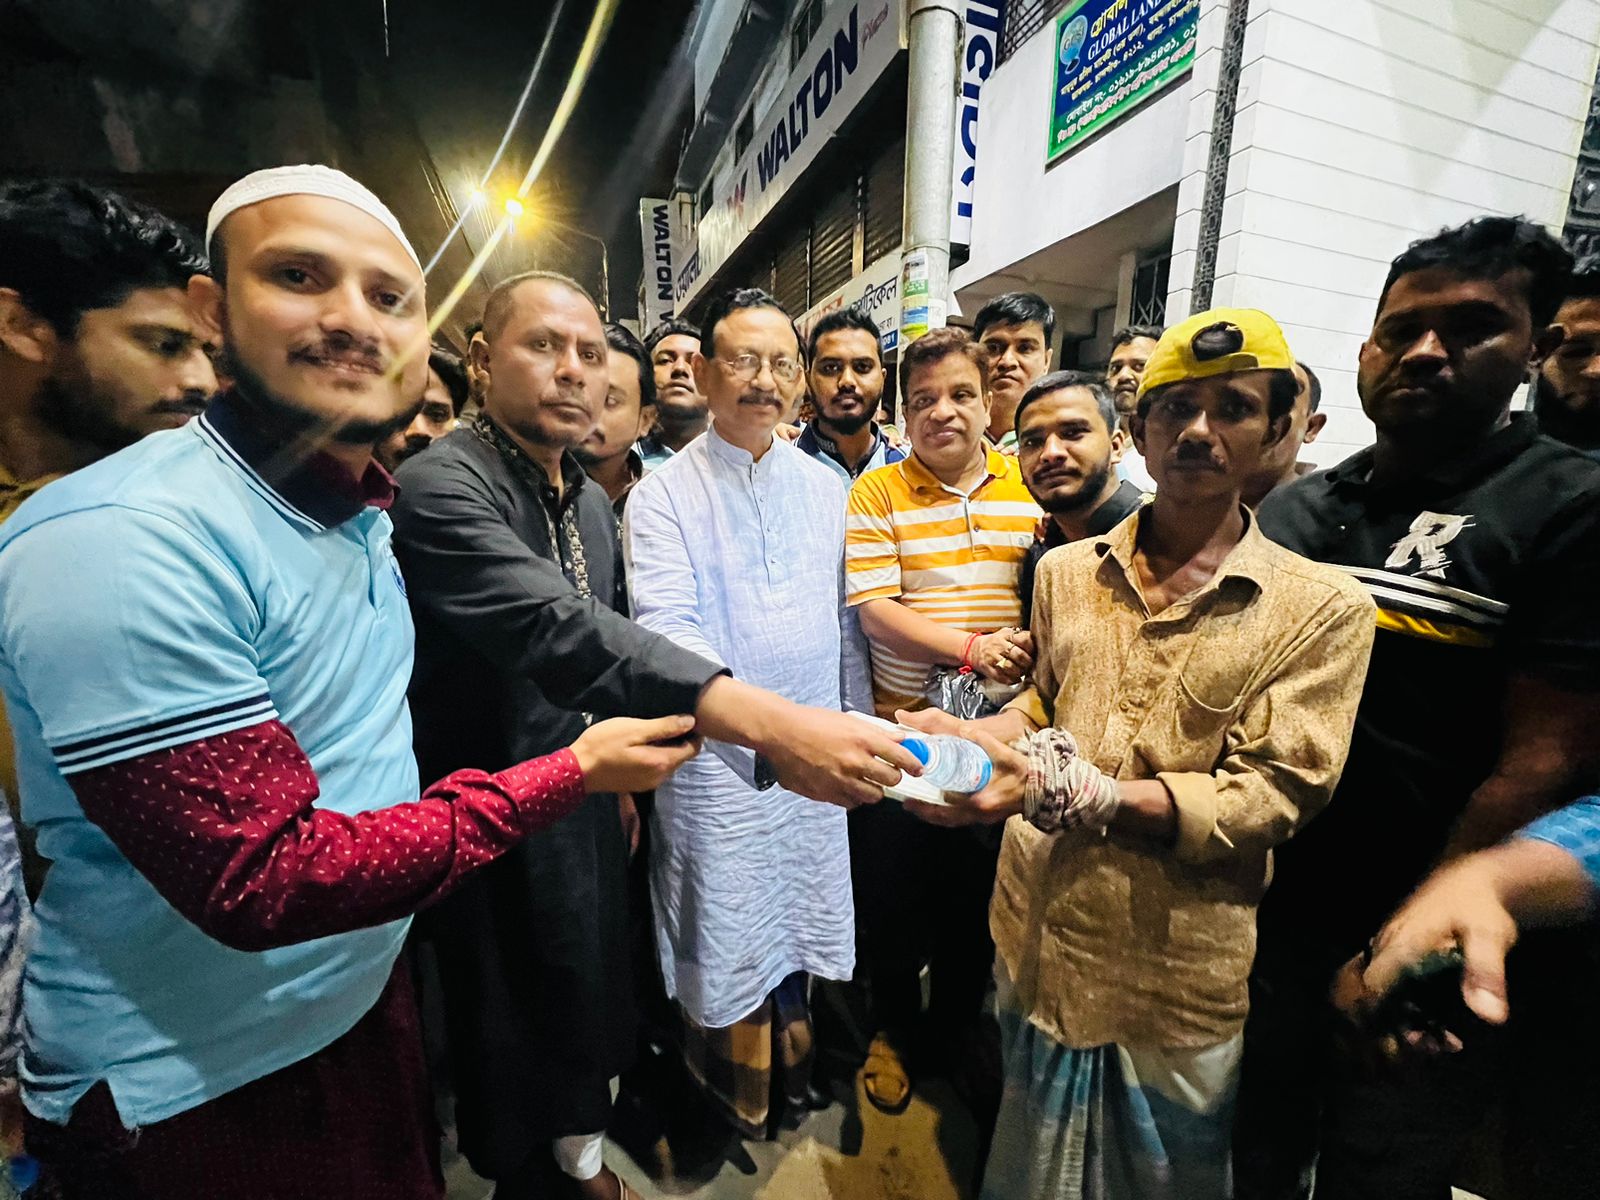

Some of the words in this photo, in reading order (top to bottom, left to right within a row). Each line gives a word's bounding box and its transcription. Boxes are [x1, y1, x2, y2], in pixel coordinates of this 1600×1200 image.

[1088, 17, 1128, 60] GLOBAL
[757, 3, 858, 193] WALTON
[653, 205, 672, 300] WALTON
